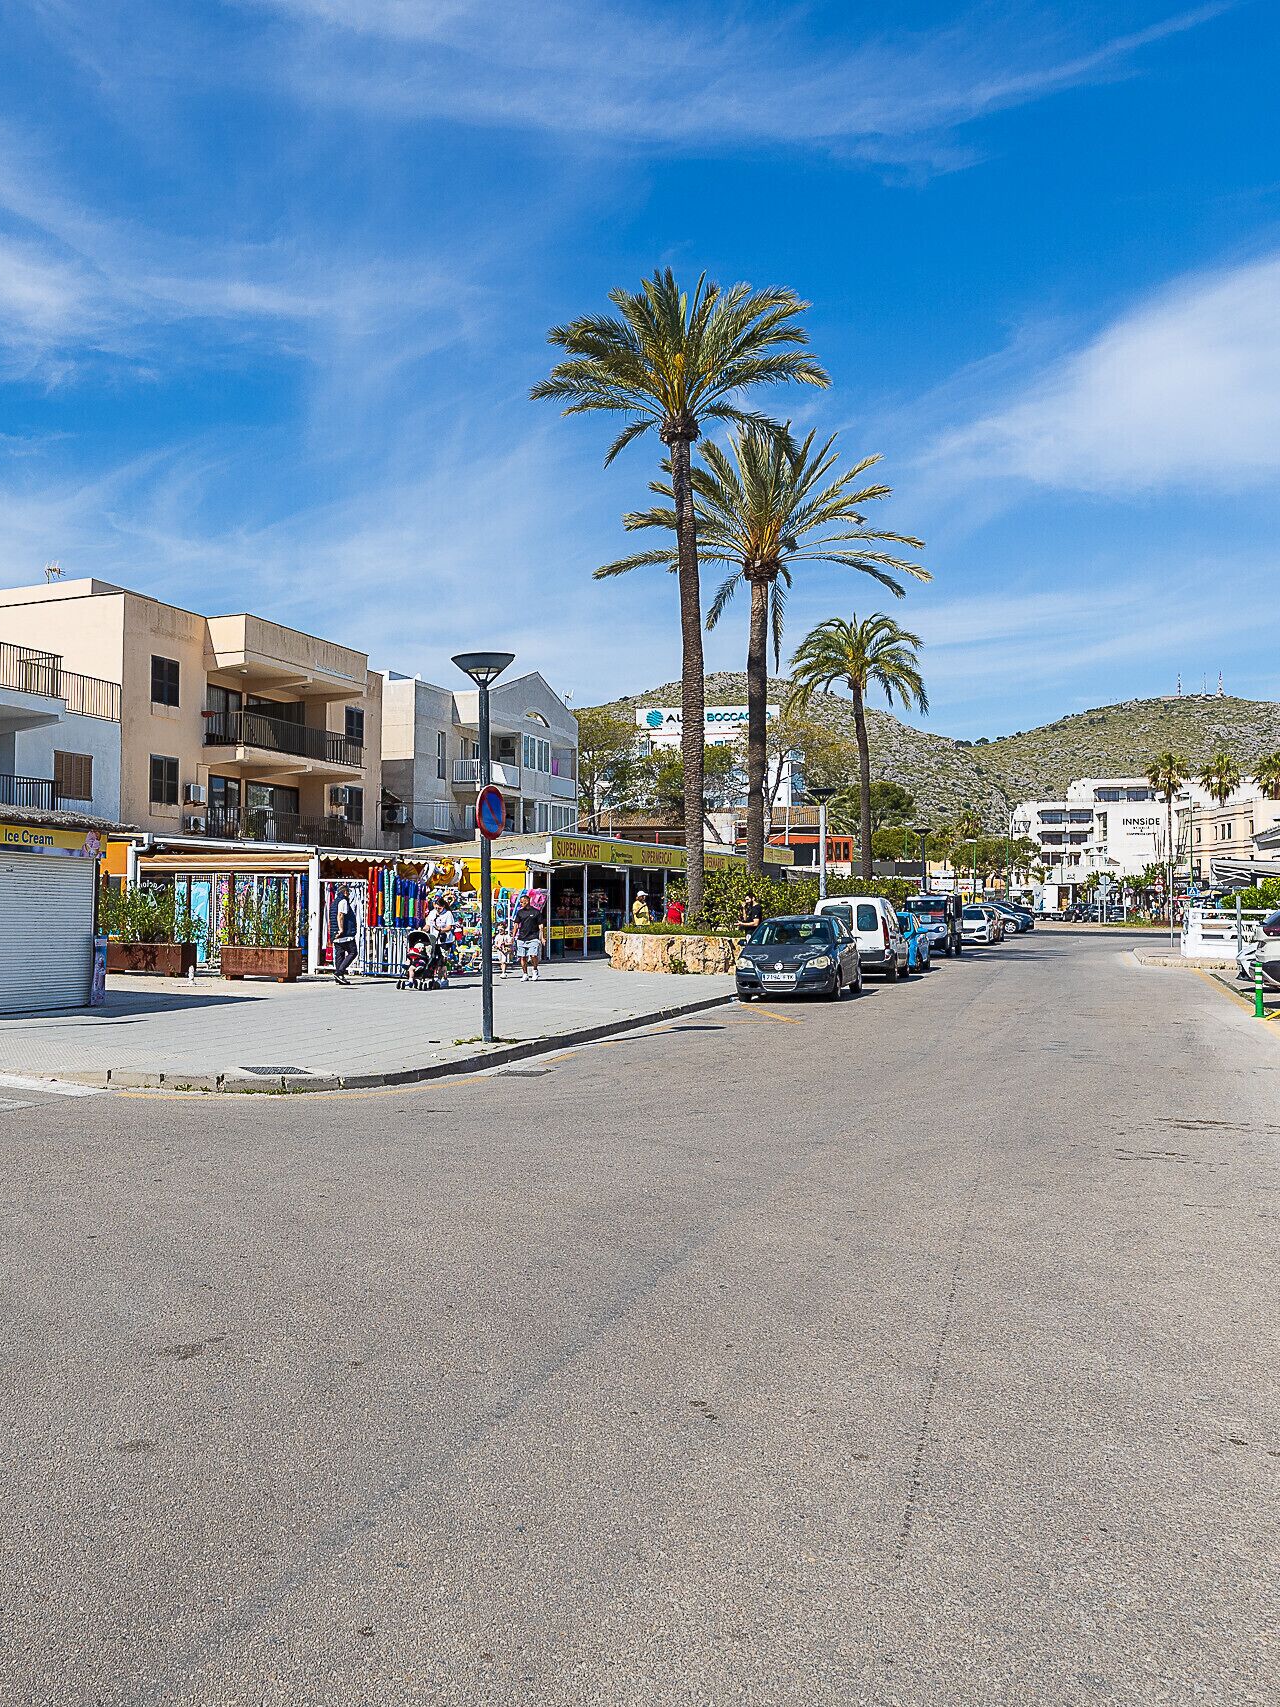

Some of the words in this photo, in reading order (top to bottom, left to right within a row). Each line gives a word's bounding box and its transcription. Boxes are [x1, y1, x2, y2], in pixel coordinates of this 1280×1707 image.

[4, 828, 19, 843] Ice
[21, 829, 54, 846] Cream
[556, 841, 600, 860] SUPERMARKET
[641, 850, 672, 865] SUPERMERCAT
